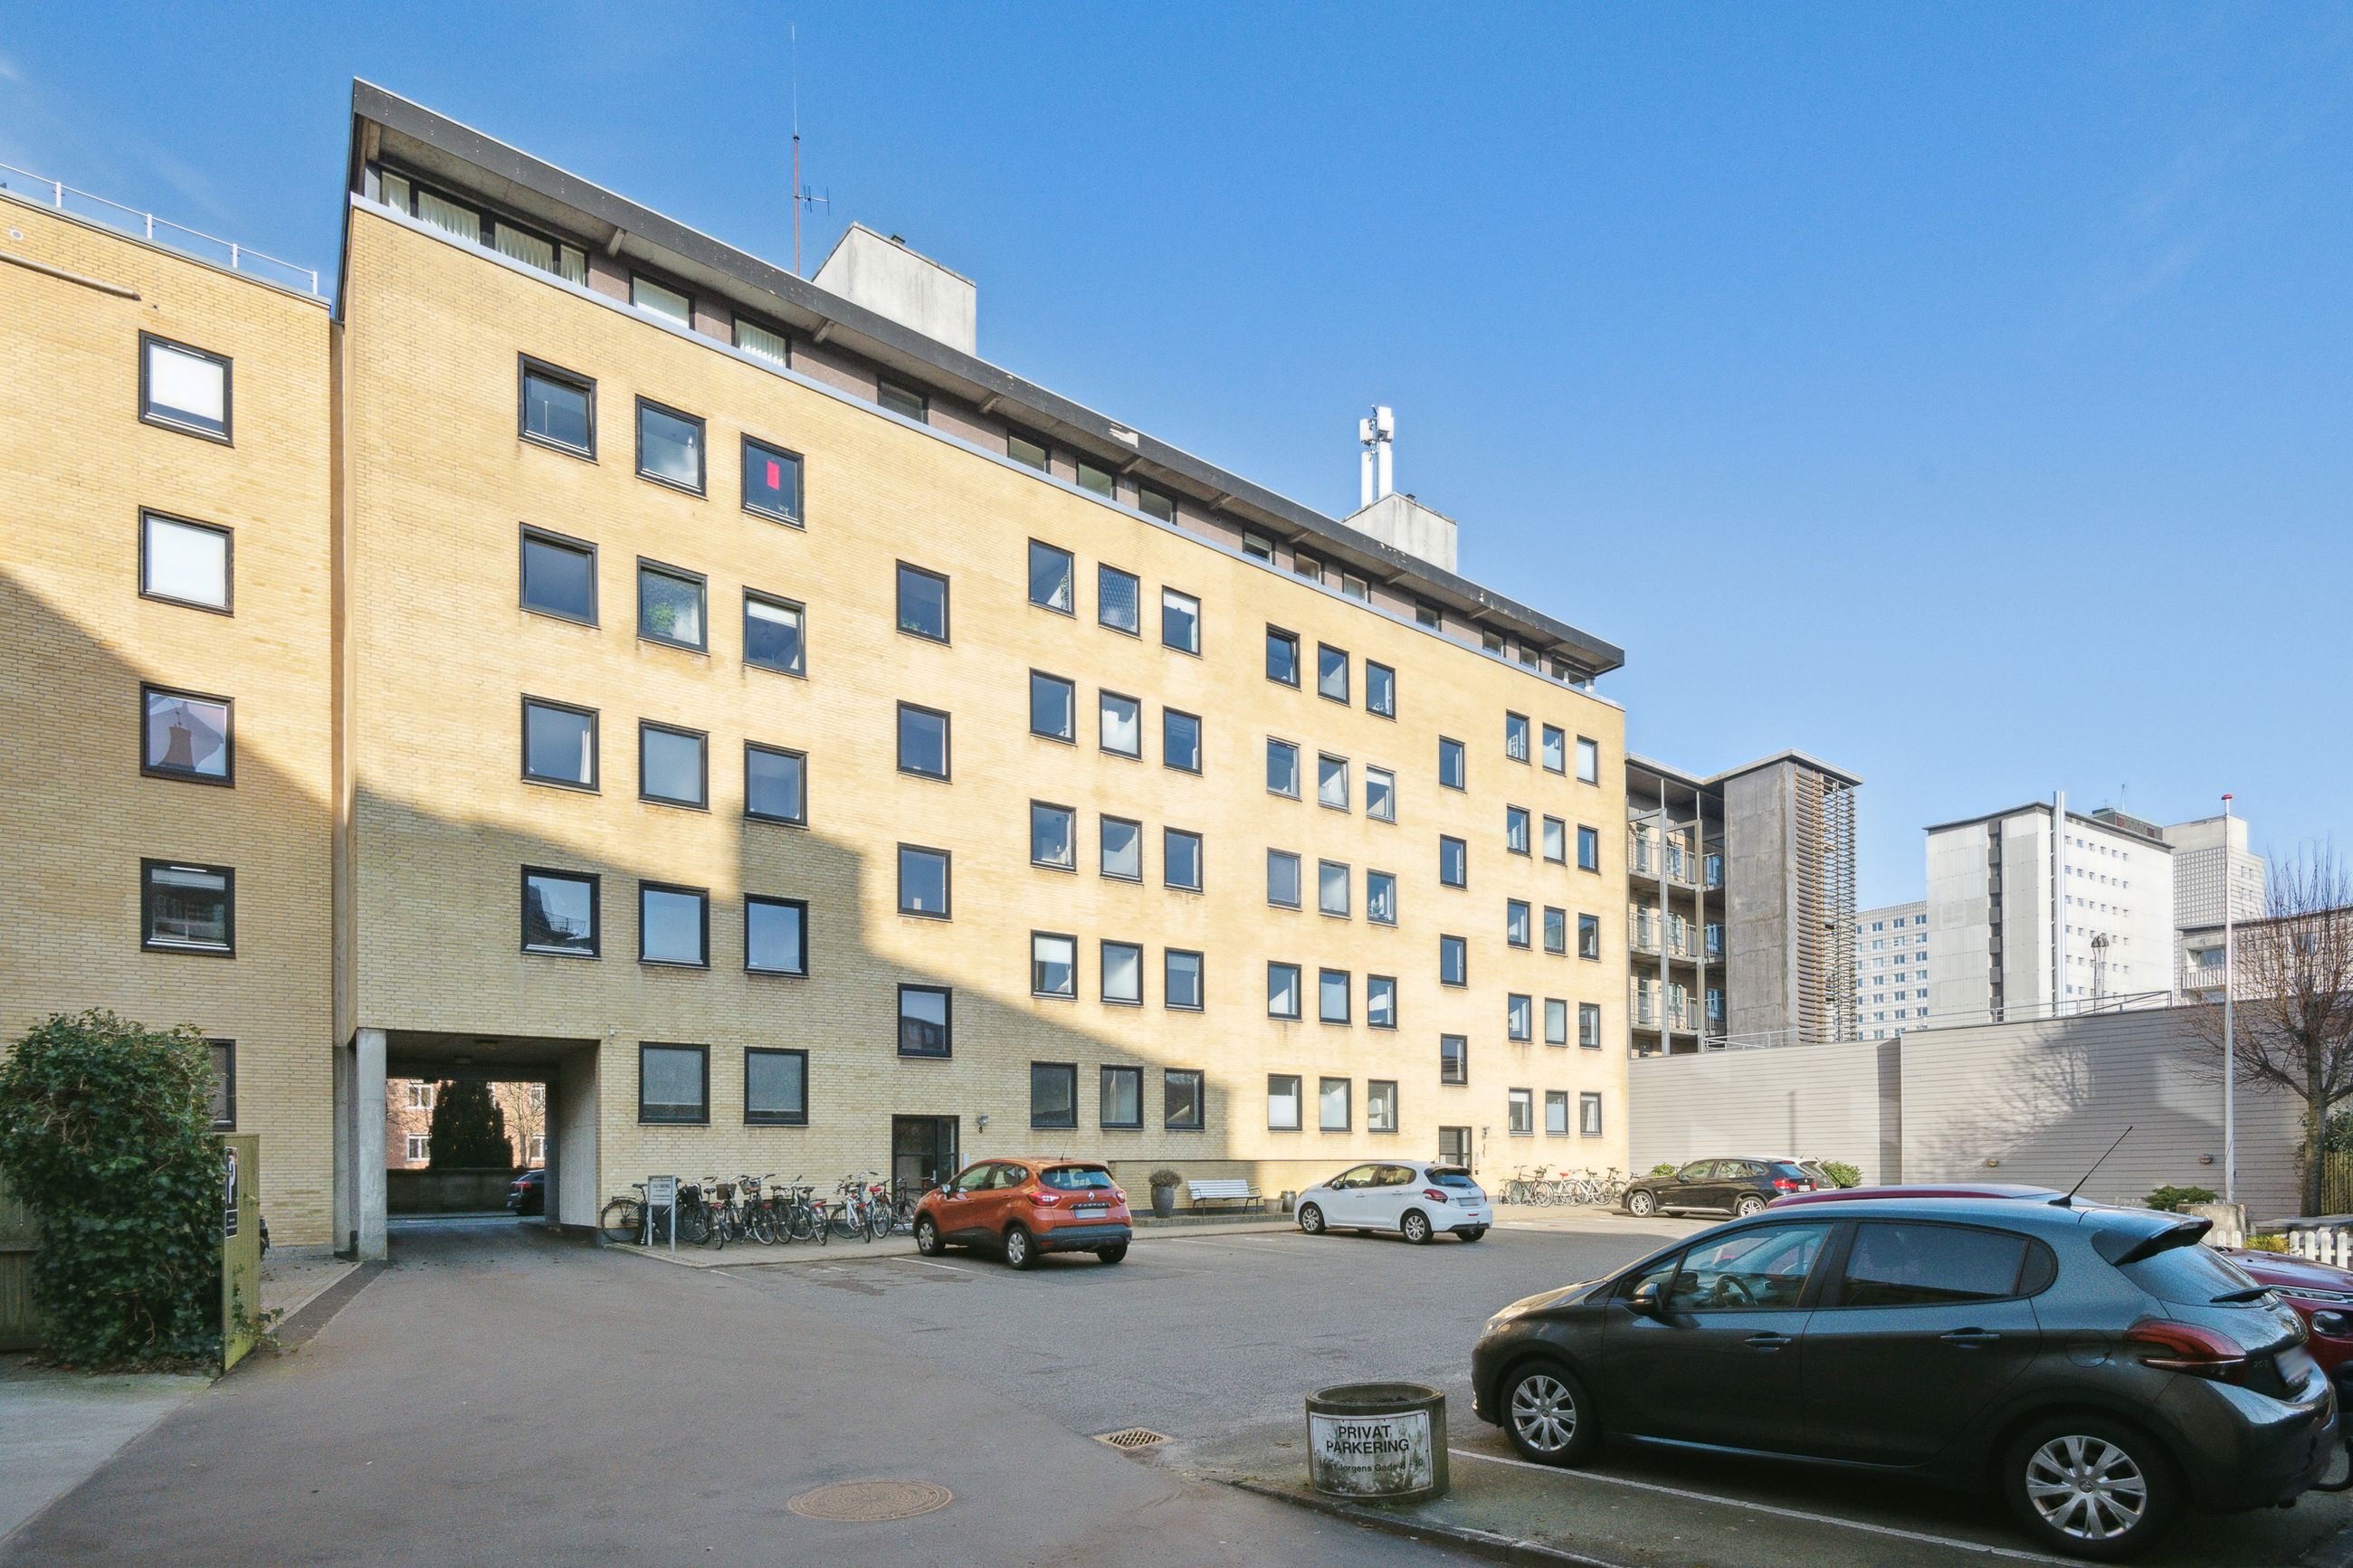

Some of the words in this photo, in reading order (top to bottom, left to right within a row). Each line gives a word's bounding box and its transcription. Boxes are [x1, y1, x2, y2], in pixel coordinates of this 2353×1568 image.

[977, 1126, 983, 1134] 8
[1338, 1425, 1391, 1439] PRIVAT
[1326, 1439, 1409, 1454] PARKERING
